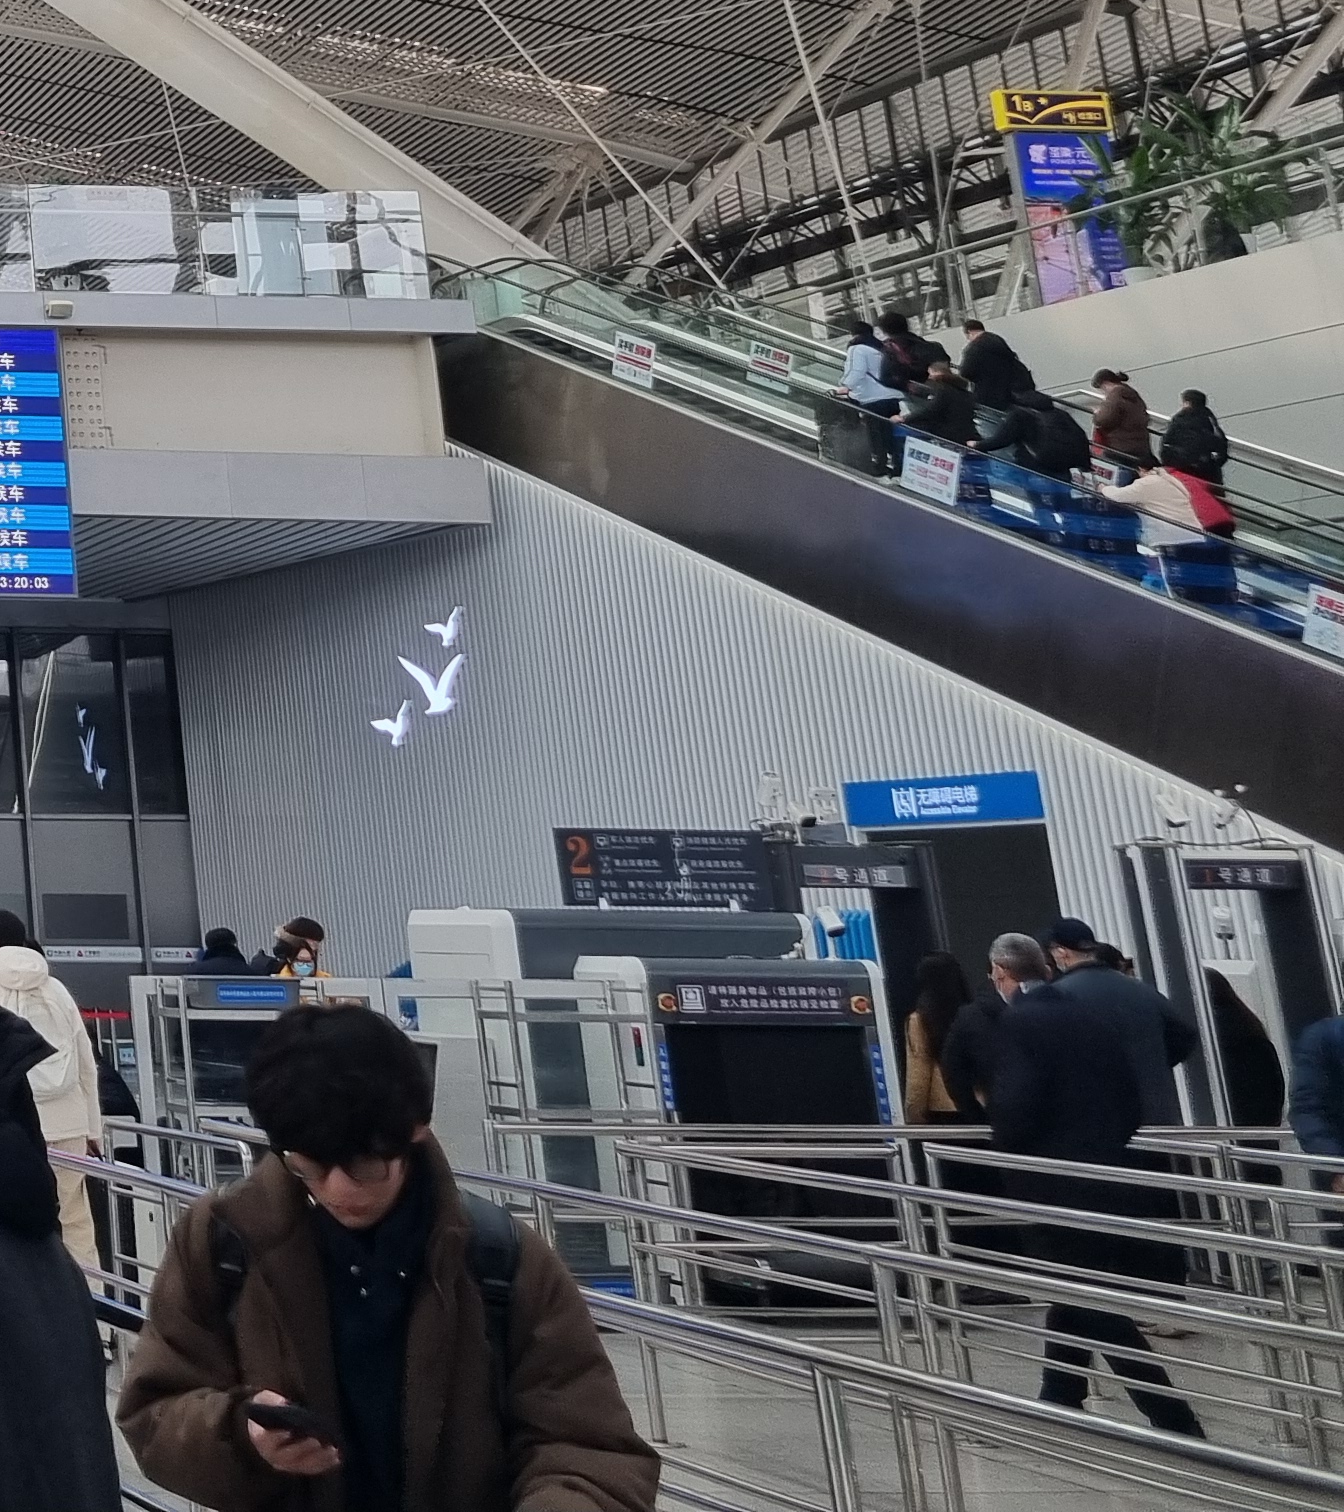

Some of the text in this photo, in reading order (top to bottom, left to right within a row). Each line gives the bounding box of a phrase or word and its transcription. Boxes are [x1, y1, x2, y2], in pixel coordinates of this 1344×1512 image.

[917, 786, 978, 805] 无障碍电梯
[566, 836, 592, 874] 2
